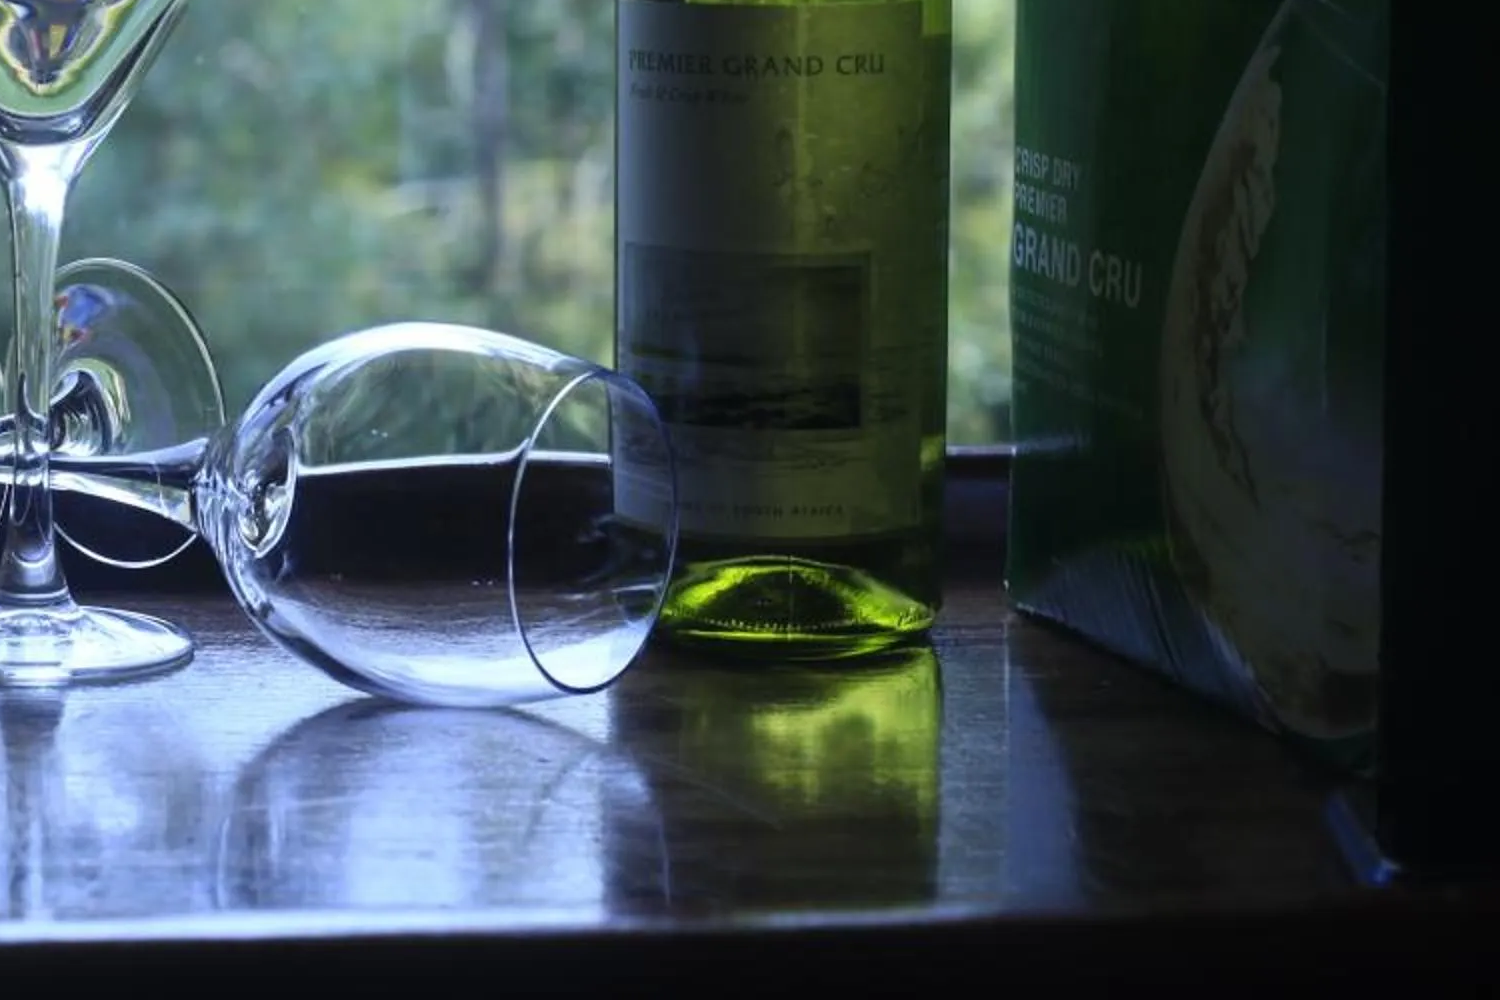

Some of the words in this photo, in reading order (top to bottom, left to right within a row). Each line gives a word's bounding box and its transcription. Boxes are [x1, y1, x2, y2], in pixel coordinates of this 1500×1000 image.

[629, 49, 712, 75] PREMIER
[722, 54, 824, 78] GRAND
[835, 53, 886, 76] CRU
[1053, 157, 1081, 192] DRY
[1014, 182, 1068, 224] PREMIER
[1013, 223, 1082, 288] GRAND
[1088, 248, 1143, 309] CRU
